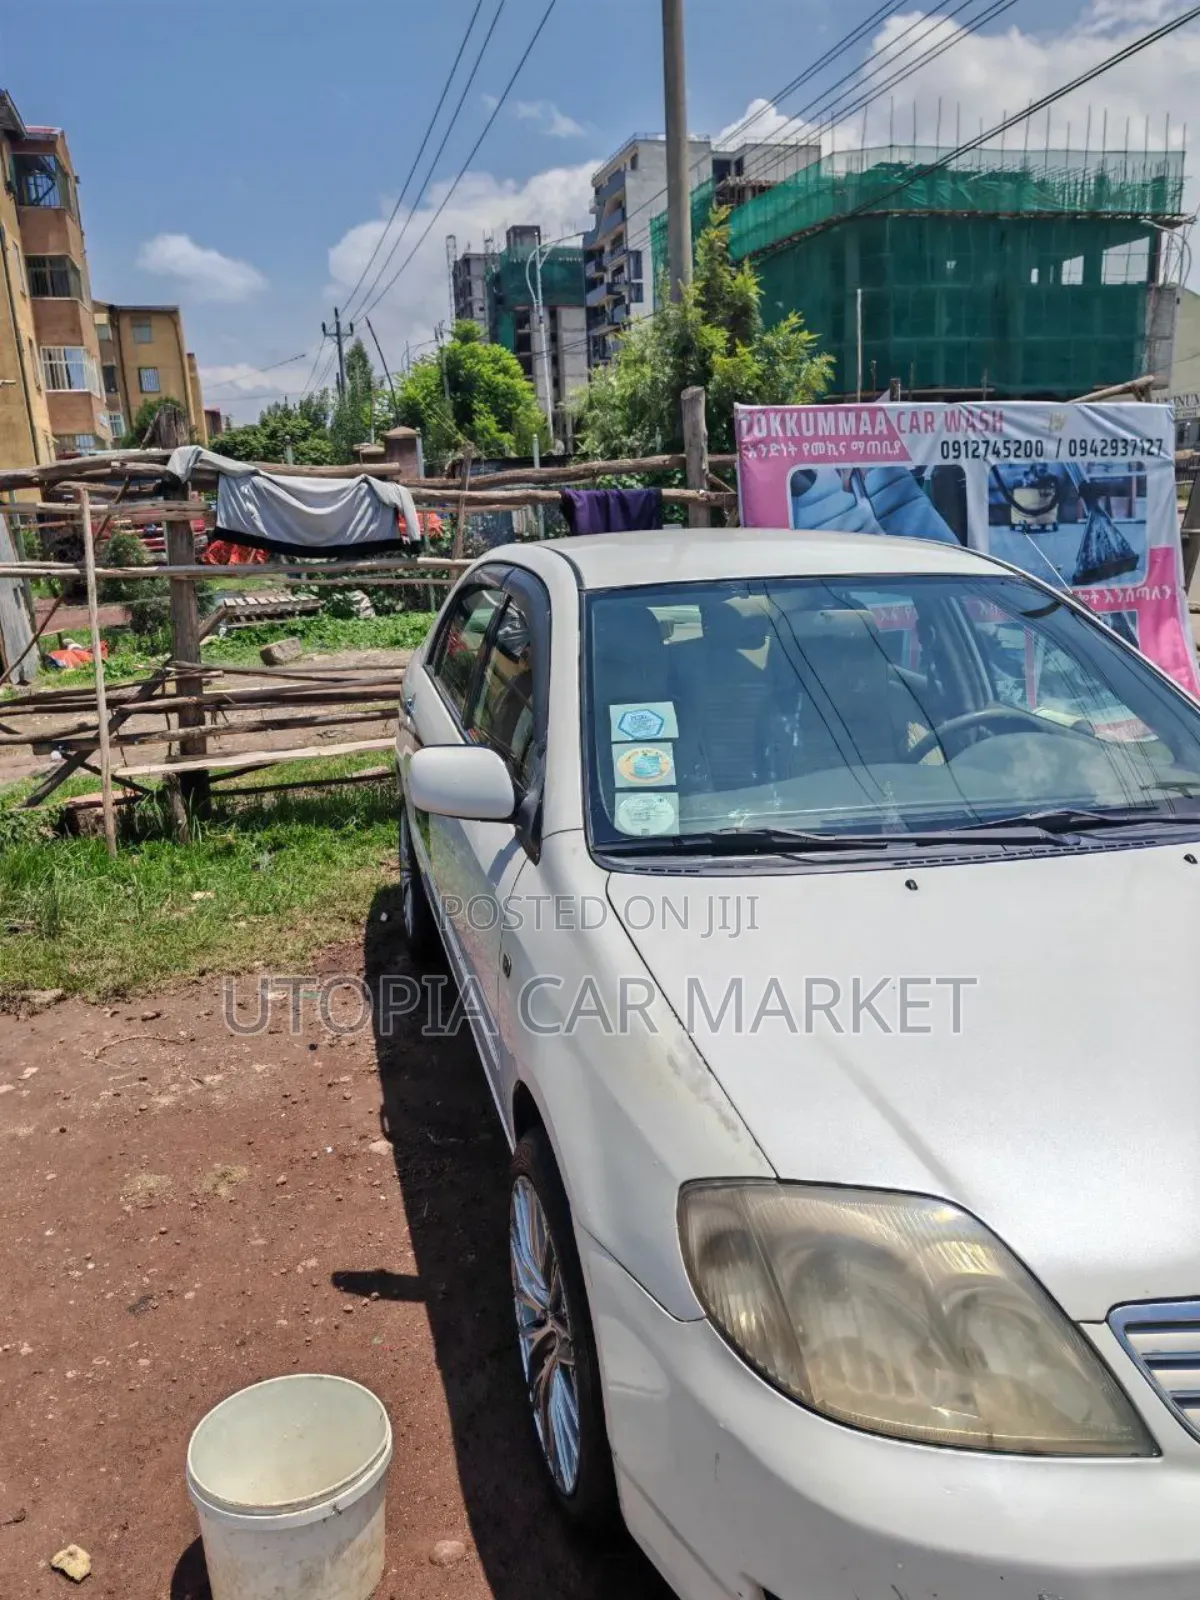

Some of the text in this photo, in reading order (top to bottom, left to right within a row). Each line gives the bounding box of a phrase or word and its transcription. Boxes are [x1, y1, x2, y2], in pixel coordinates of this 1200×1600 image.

[897, 410, 935, 434] CAR
[944, 410, 1004, 433] WASH
[802, 441, 846, 457] የመኪና
[940, 440, 1044, 460] 0912745200
[1068, 438, 1163, 458] 0942937127
